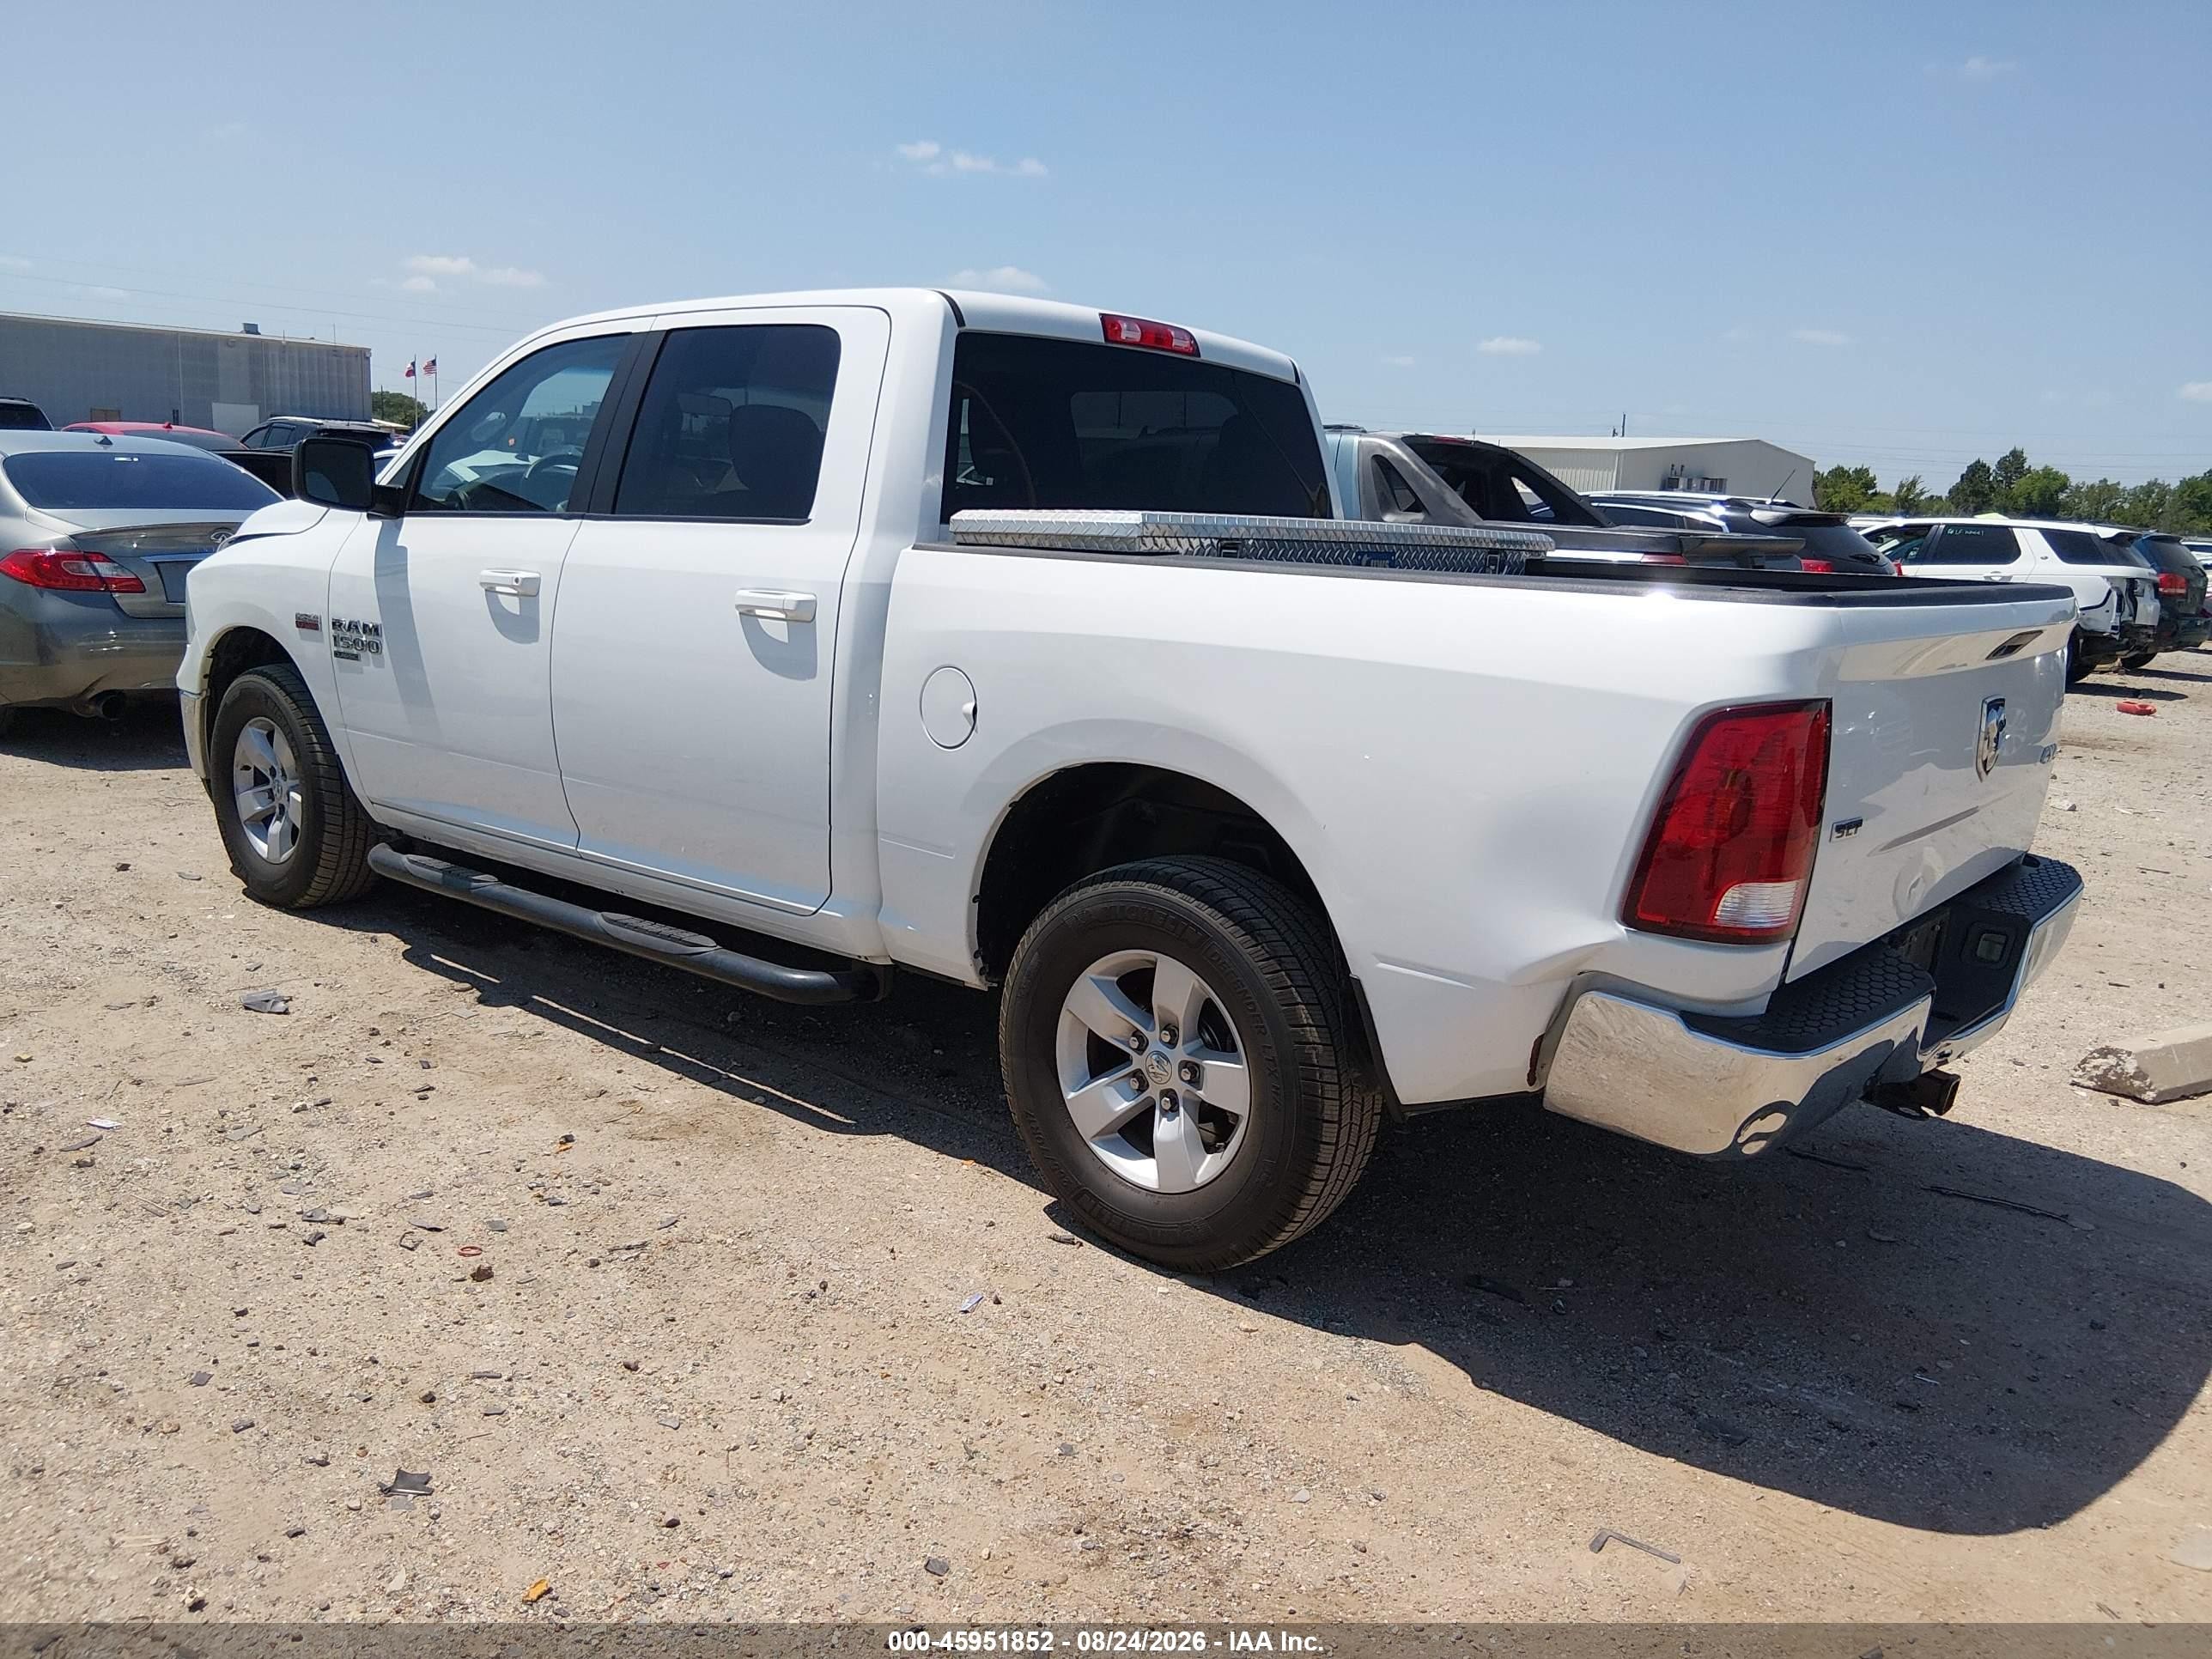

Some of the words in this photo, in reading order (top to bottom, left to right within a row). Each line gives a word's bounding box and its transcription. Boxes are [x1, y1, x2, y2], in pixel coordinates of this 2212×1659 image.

[331, 617, 383, 636] RAM
[332, 635, 383, 654] 1500
[1834, 818, 1863, 839] SLT
[1211, 951, 1268, 1036] DEFENDER
